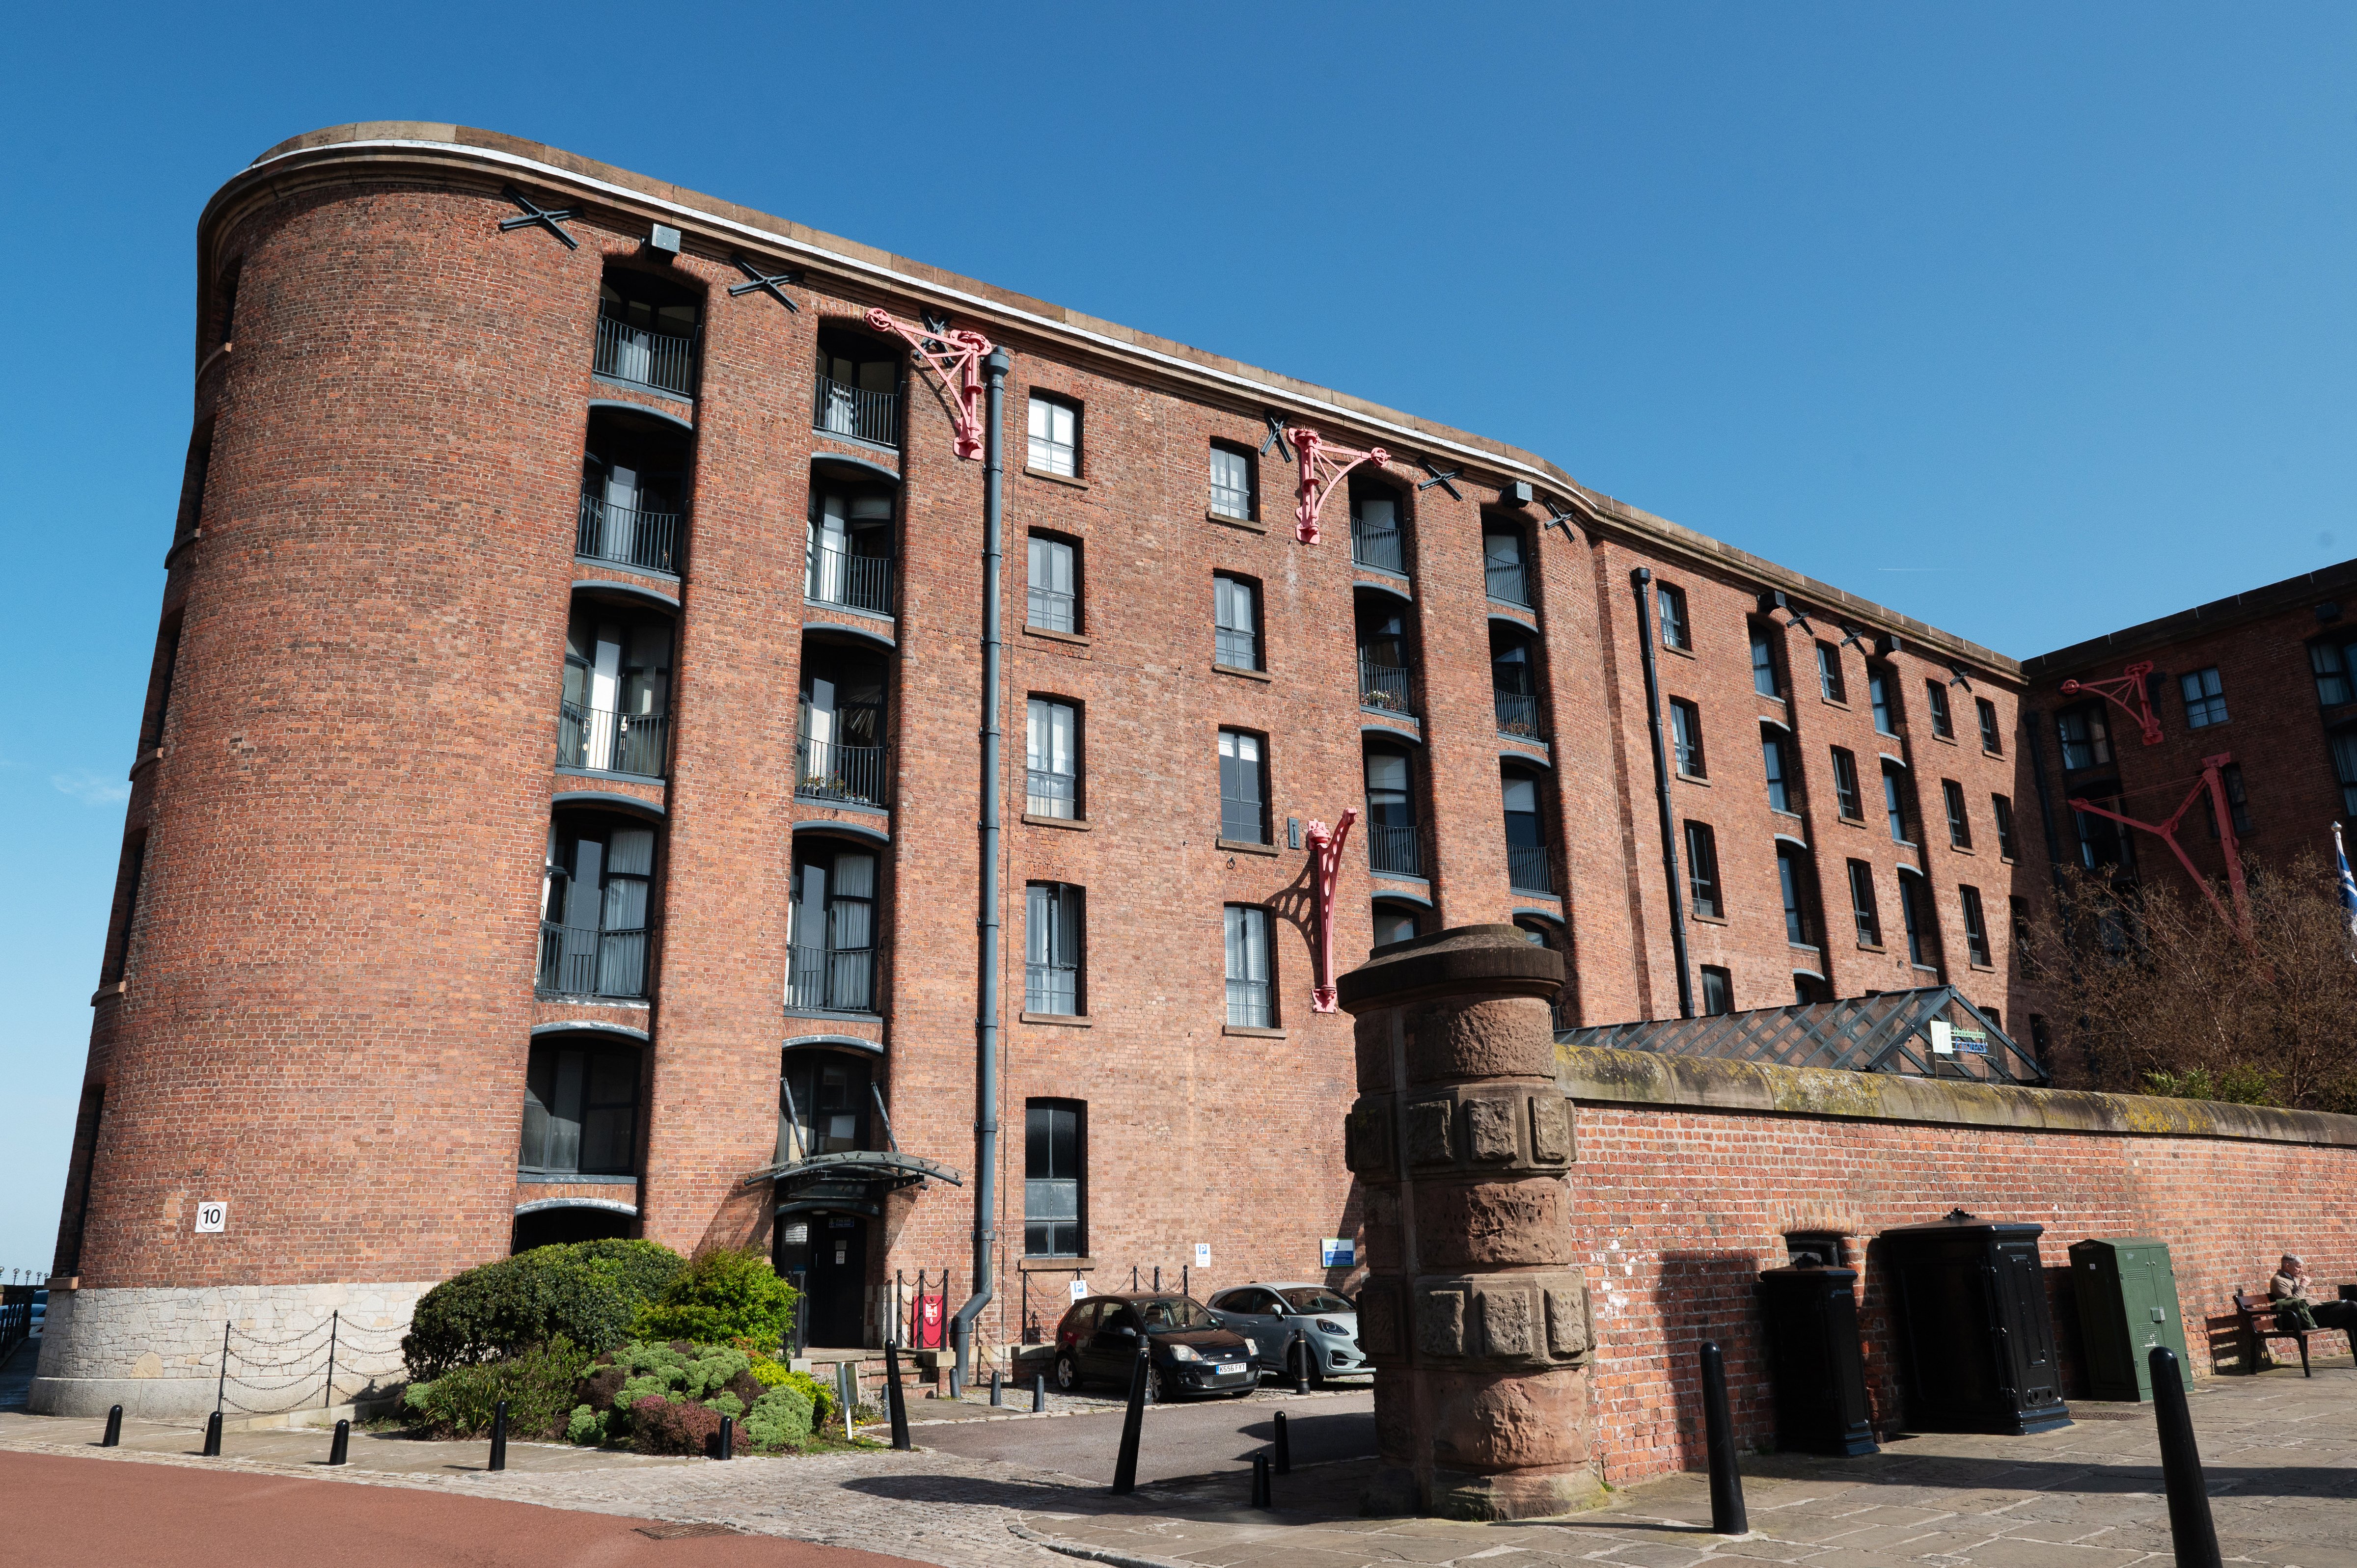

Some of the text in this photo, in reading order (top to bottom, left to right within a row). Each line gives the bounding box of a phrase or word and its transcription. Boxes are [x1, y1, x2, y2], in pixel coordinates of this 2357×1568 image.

[1955, 1038, 1987, 1054] Express
[203, 1209, 220, 1224] 10
[1200, 1245, 1206, 1254] P
[1075, 1282, 1082, 1292] P
